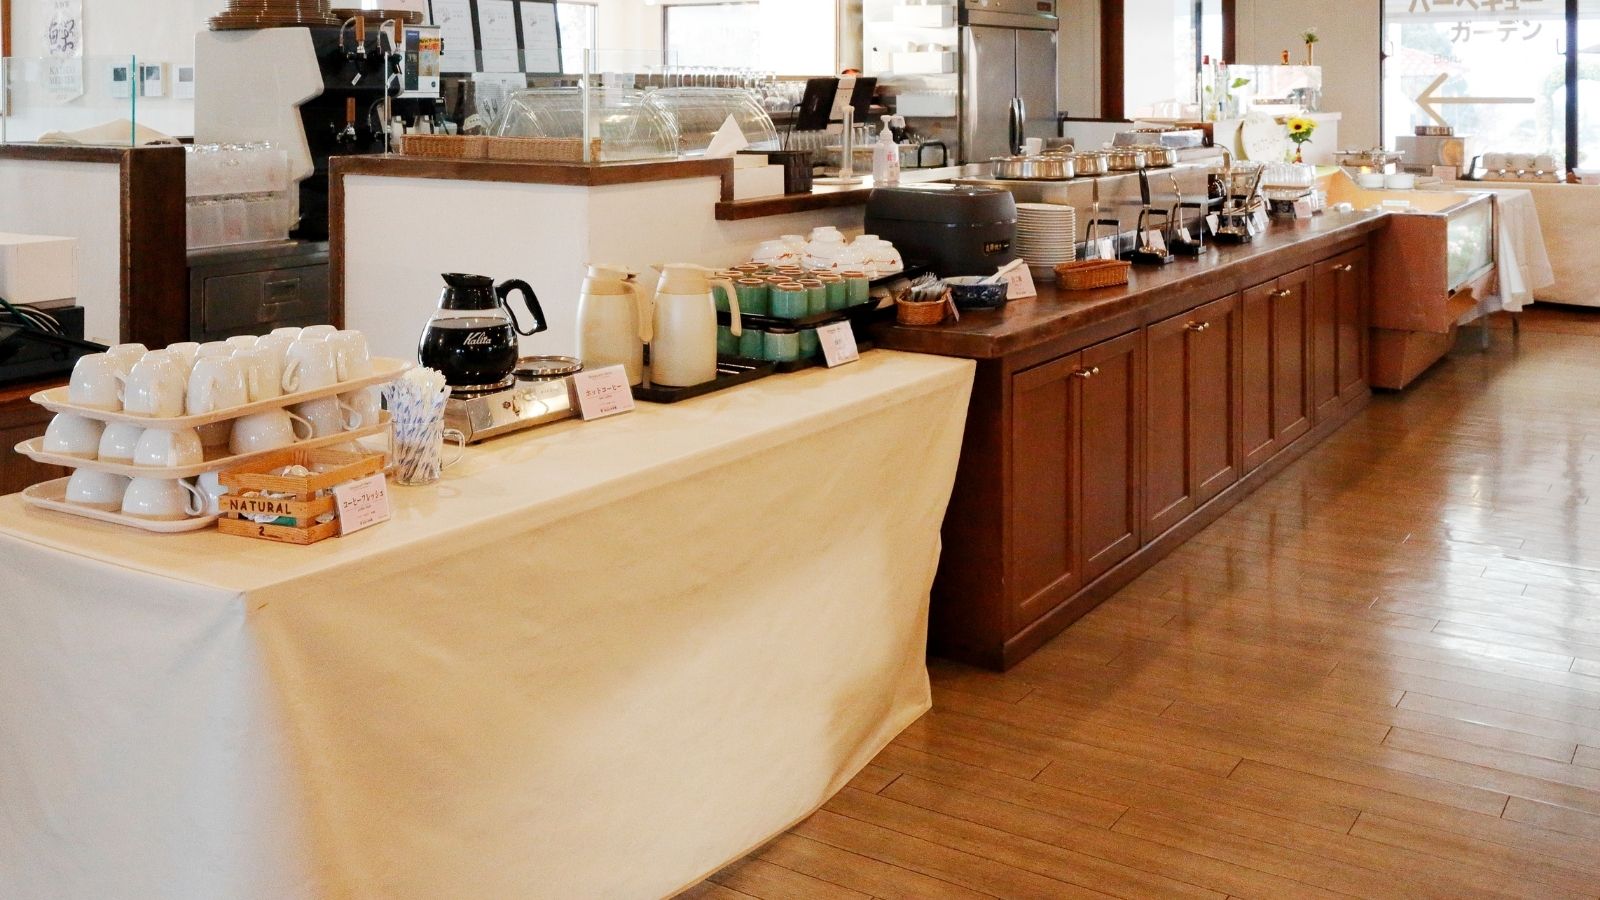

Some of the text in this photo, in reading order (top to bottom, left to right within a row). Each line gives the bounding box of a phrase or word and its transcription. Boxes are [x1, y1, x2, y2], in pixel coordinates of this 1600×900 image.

[1451, 20, 1542, 43] ガーデン
[463, 331, 492, 346] Kalita
[585, 384, 622, 397] ホットコーヒー
[343, 489, 384, 509] コーヒーフレッシュ
[229, 499, 292, 515] NATURAL
[258, 526, 265, 536] 2
